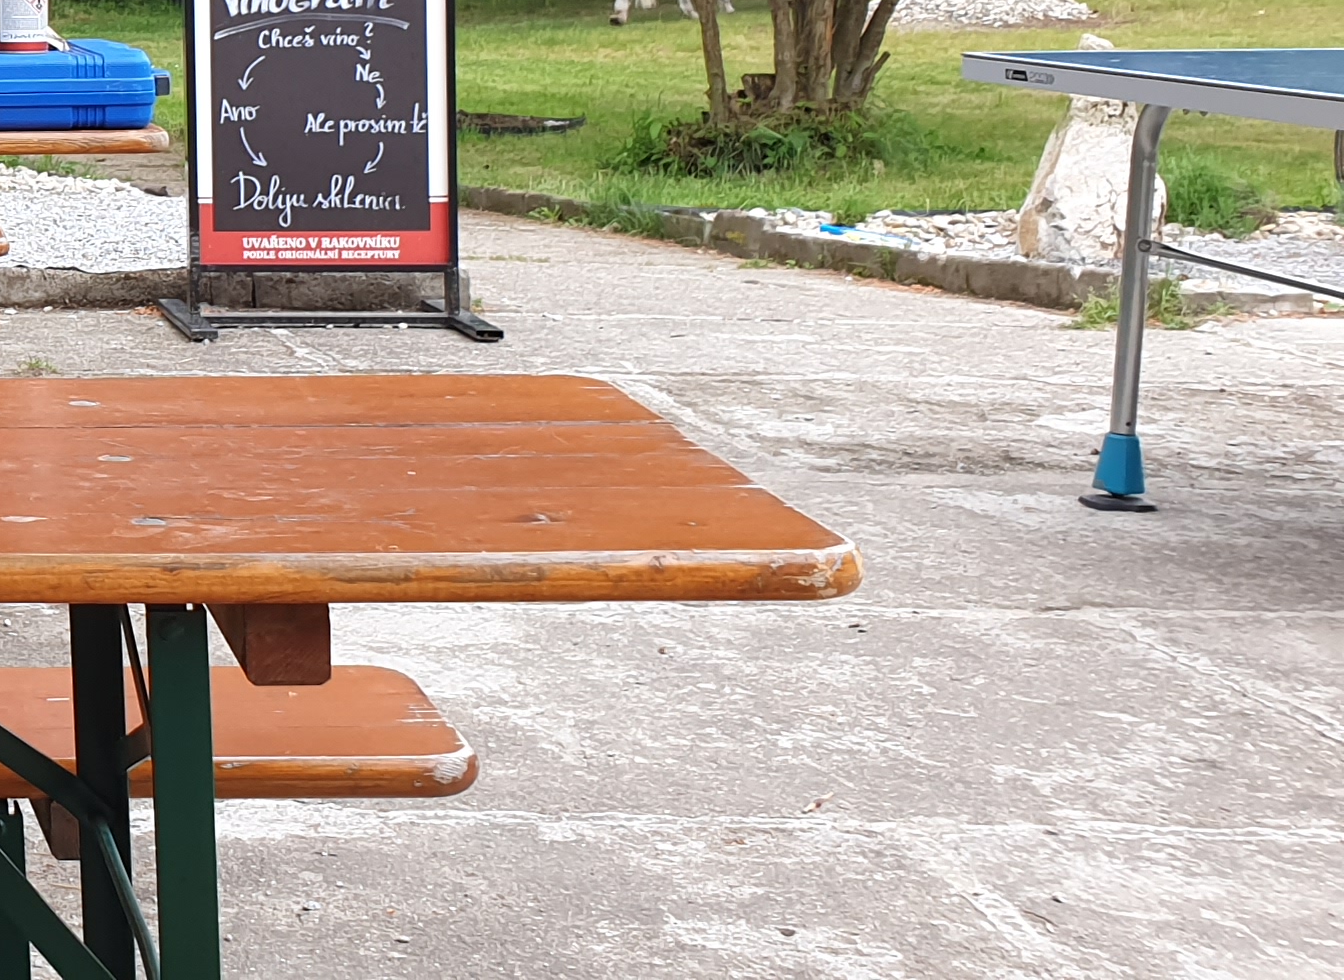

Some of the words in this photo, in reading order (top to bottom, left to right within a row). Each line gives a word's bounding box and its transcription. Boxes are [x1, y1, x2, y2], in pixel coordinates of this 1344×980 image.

[355, 63, 384, 83] Ne
[220, 98, 261, 125] Ano
[242, 235, 306, 249] UVAŘENO
[308, 237, 319, 249] V
[321, 234, 400, 249] RAKOVNÍKU
[243, 250, 276, 259] PODLE
